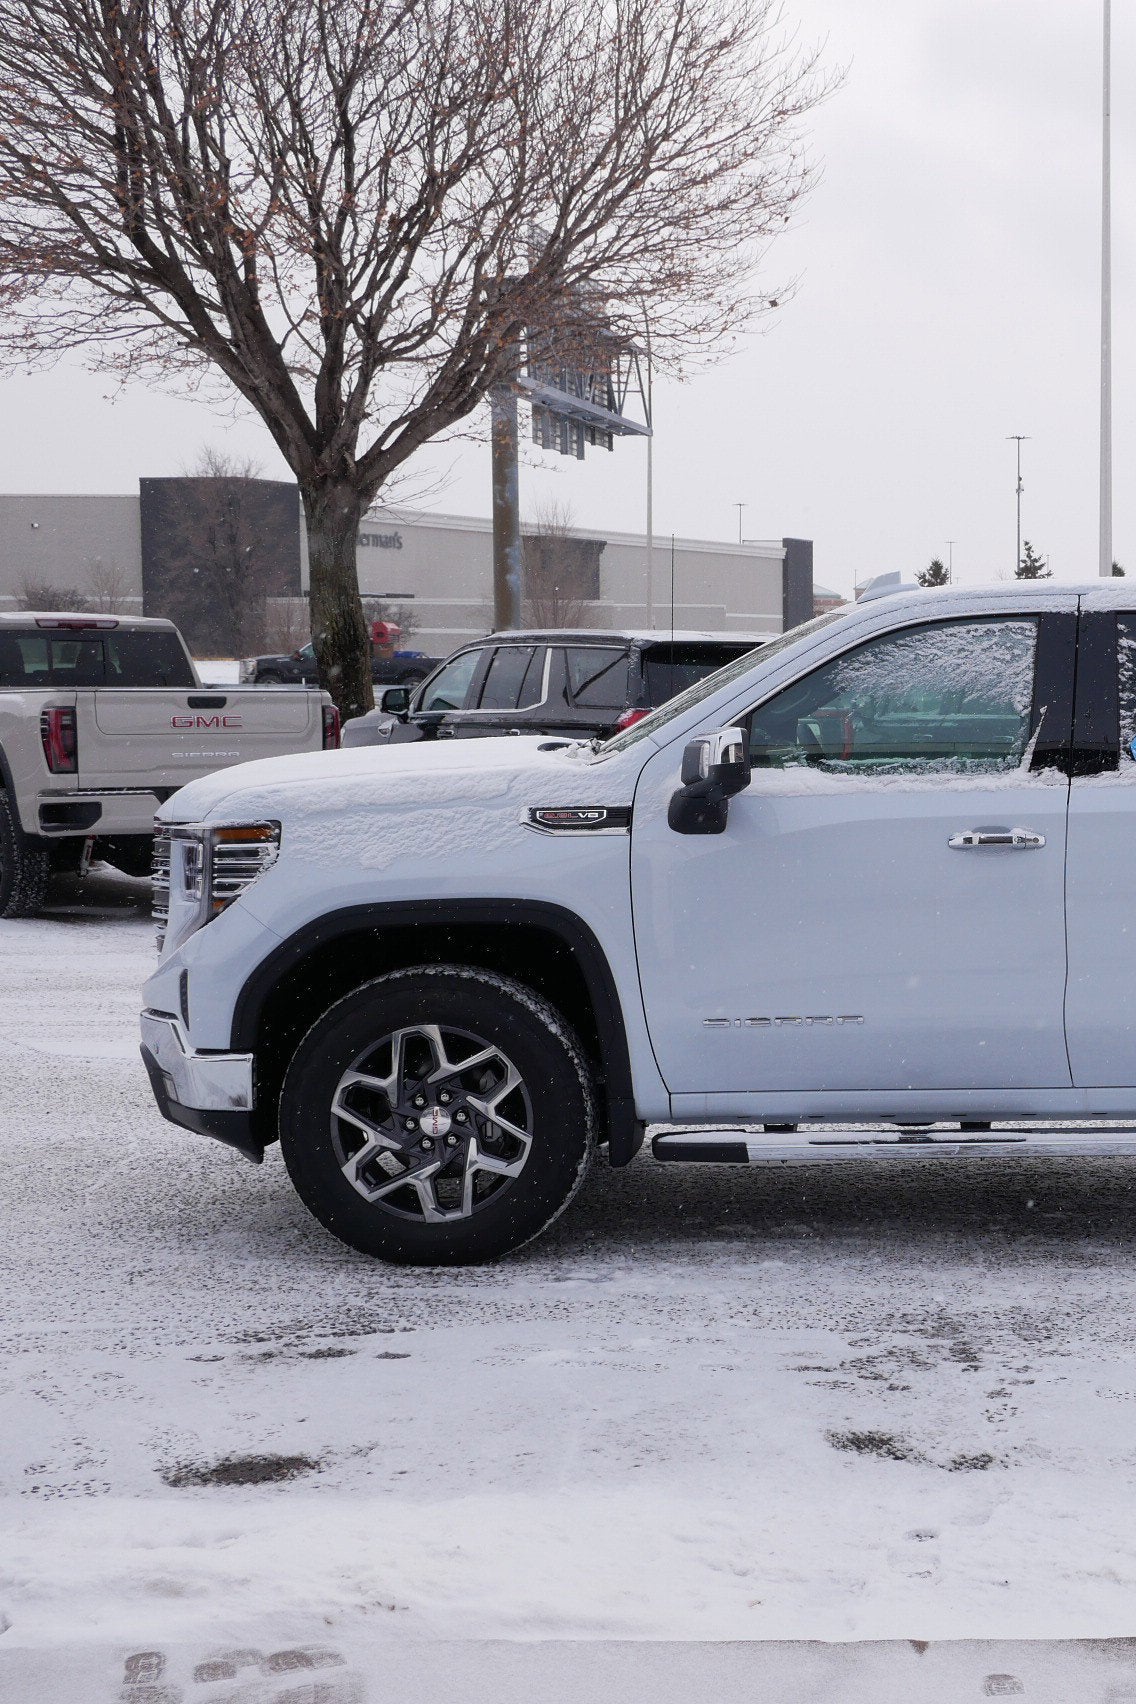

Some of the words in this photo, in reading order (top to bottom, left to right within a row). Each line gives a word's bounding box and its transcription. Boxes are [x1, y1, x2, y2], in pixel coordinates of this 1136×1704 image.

[170, 715, 243, 729] GMC
[702, 1015, 865, 1028] SIERRA
[432, 1108, 440, 1135] GMC
